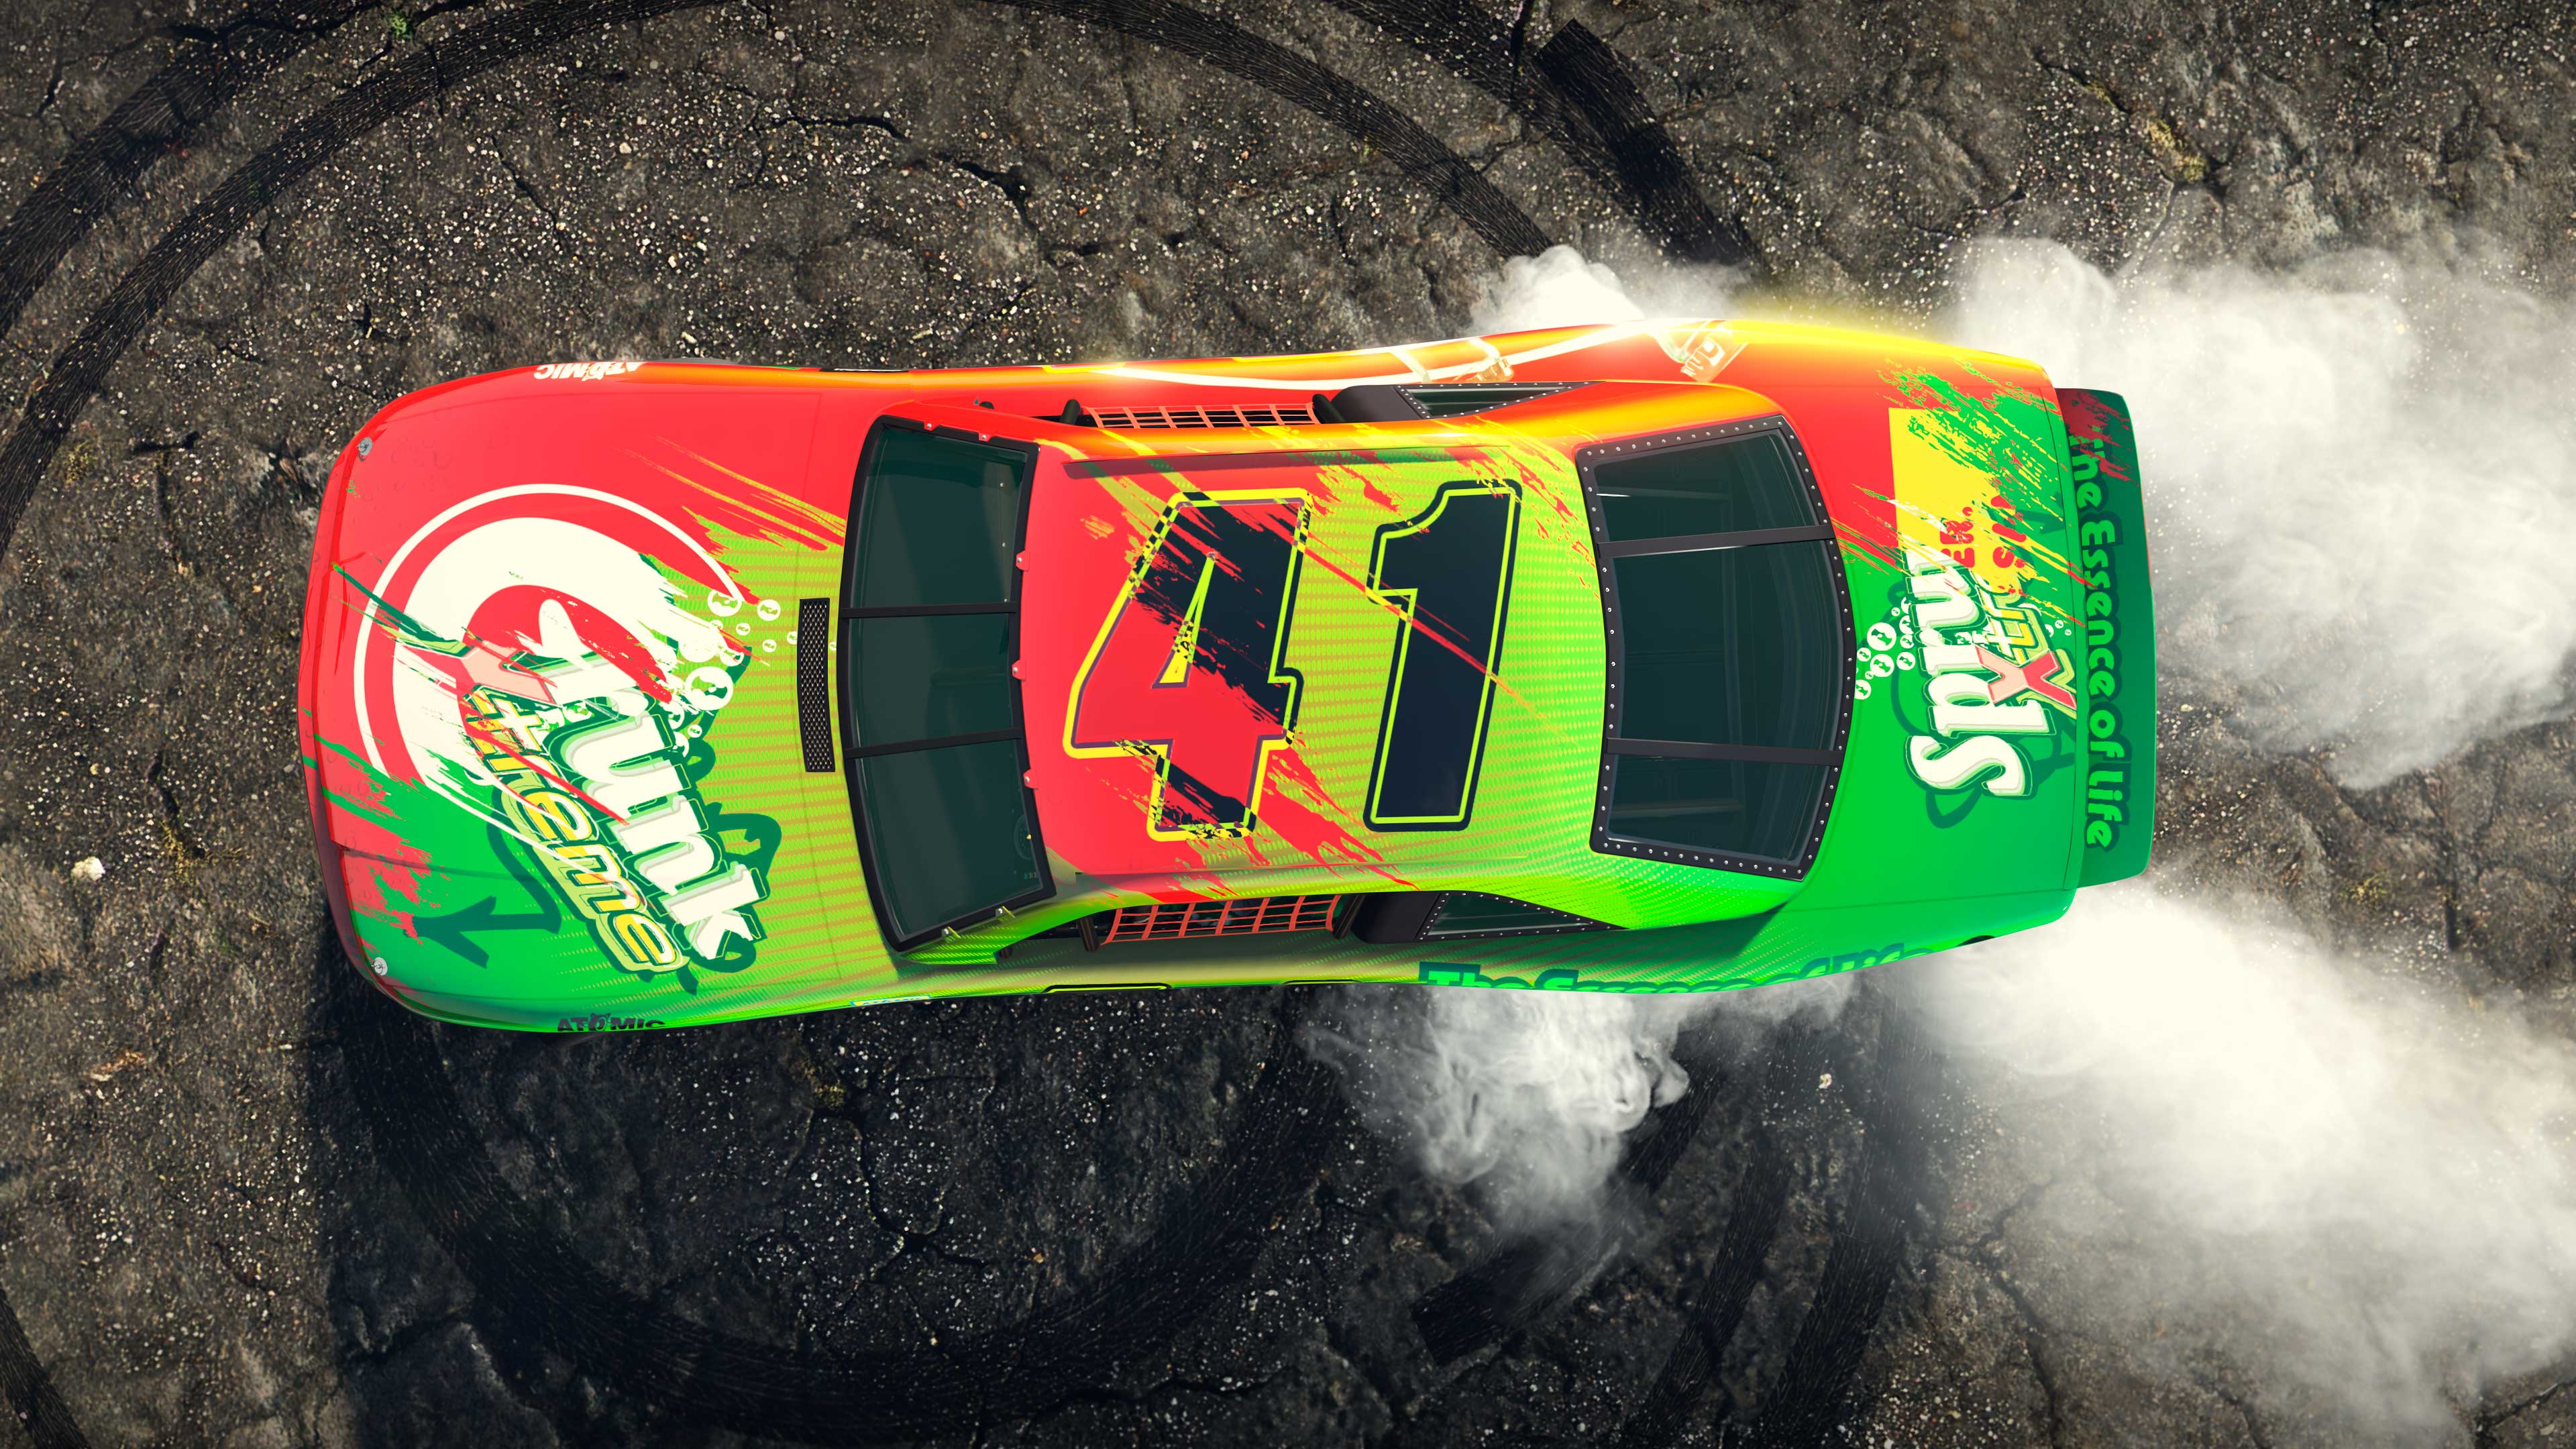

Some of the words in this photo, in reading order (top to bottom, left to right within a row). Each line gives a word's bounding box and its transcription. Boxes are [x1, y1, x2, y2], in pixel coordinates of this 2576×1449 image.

[1063, 480, 1521, 841] 41
[2082, 520, 2116, 697] Essence
[2089, 710, 2125, 757] of
[2086, 771, 2123, 847] Life
